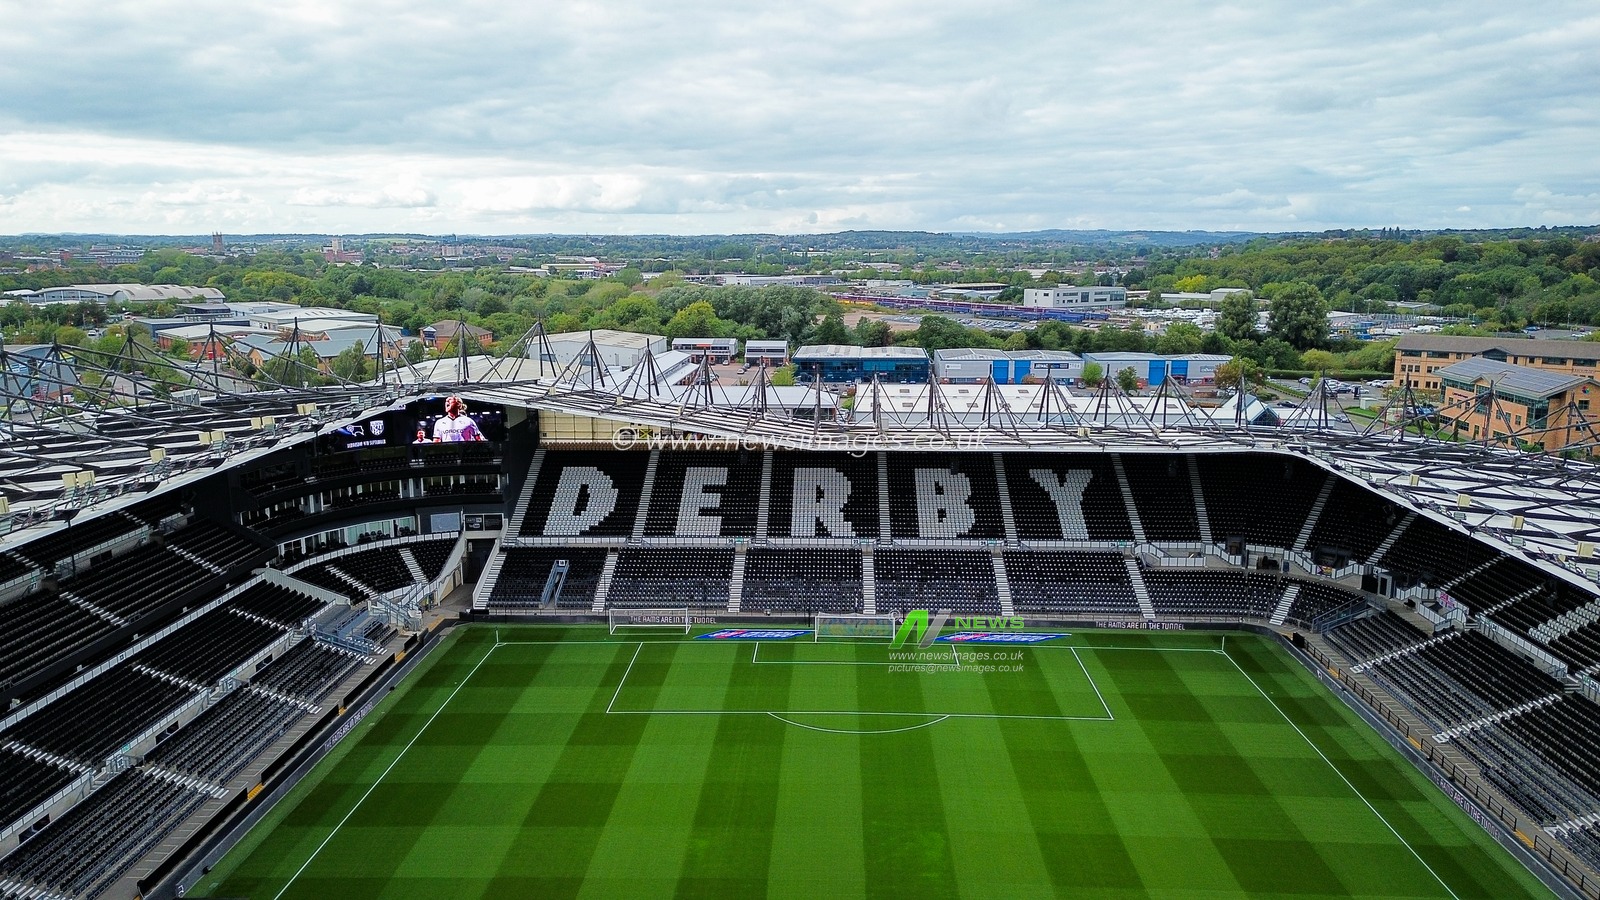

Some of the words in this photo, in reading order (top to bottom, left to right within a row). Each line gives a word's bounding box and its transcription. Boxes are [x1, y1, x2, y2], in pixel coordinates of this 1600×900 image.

[542, 466, 1093, 541] DERBY
[660, 616, 673, 624] ARE
[1108, 621, 1126, 629] RAMS
